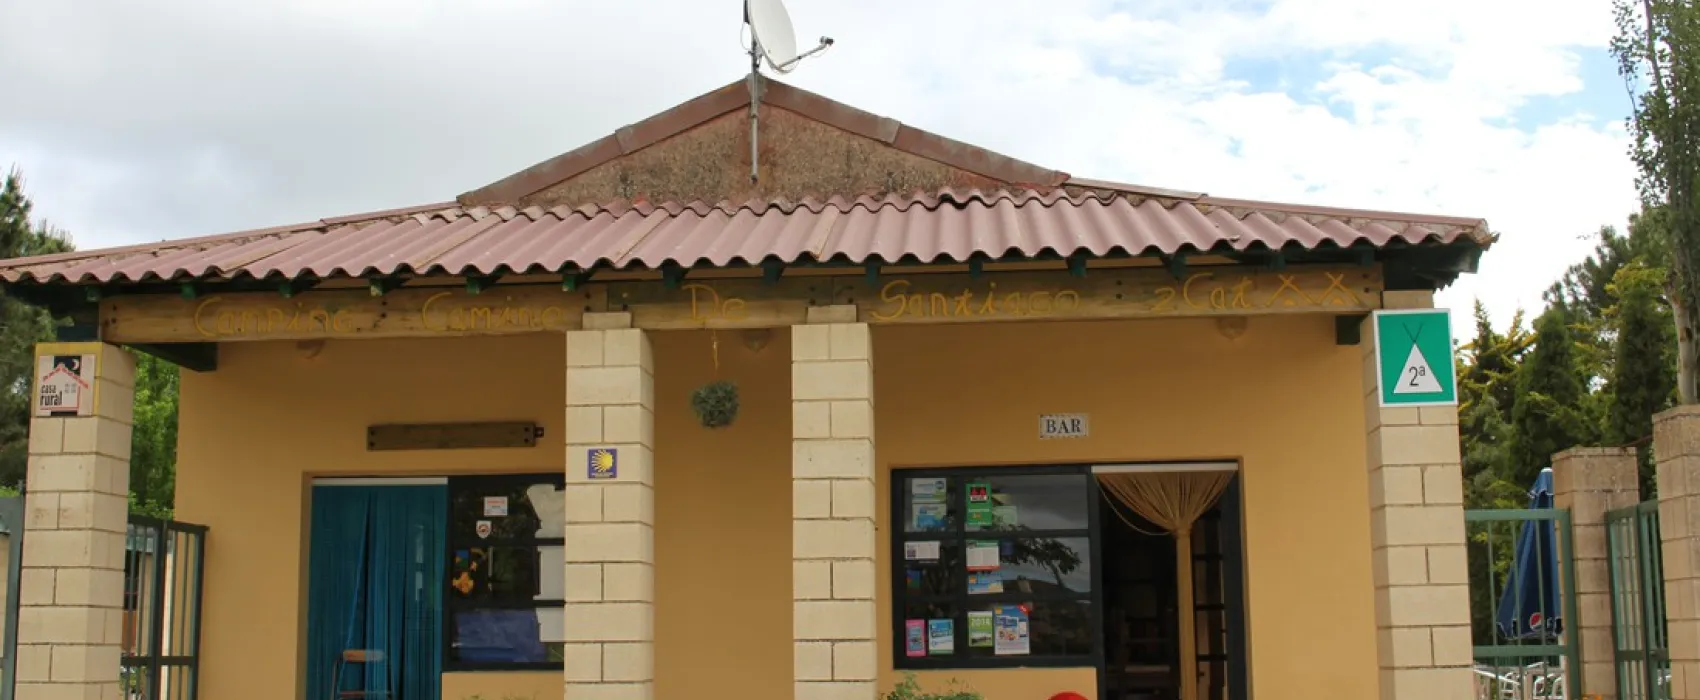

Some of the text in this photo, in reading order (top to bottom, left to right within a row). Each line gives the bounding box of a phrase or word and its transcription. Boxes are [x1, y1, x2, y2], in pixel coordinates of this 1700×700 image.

[681, 283, 747, 323] De
[870, 279, 1080, 321] Santiago
[41, 384, 57, 393] casa
[40, 391, 62, 406] rural
[1046, 418, 1081, 434] BAR
